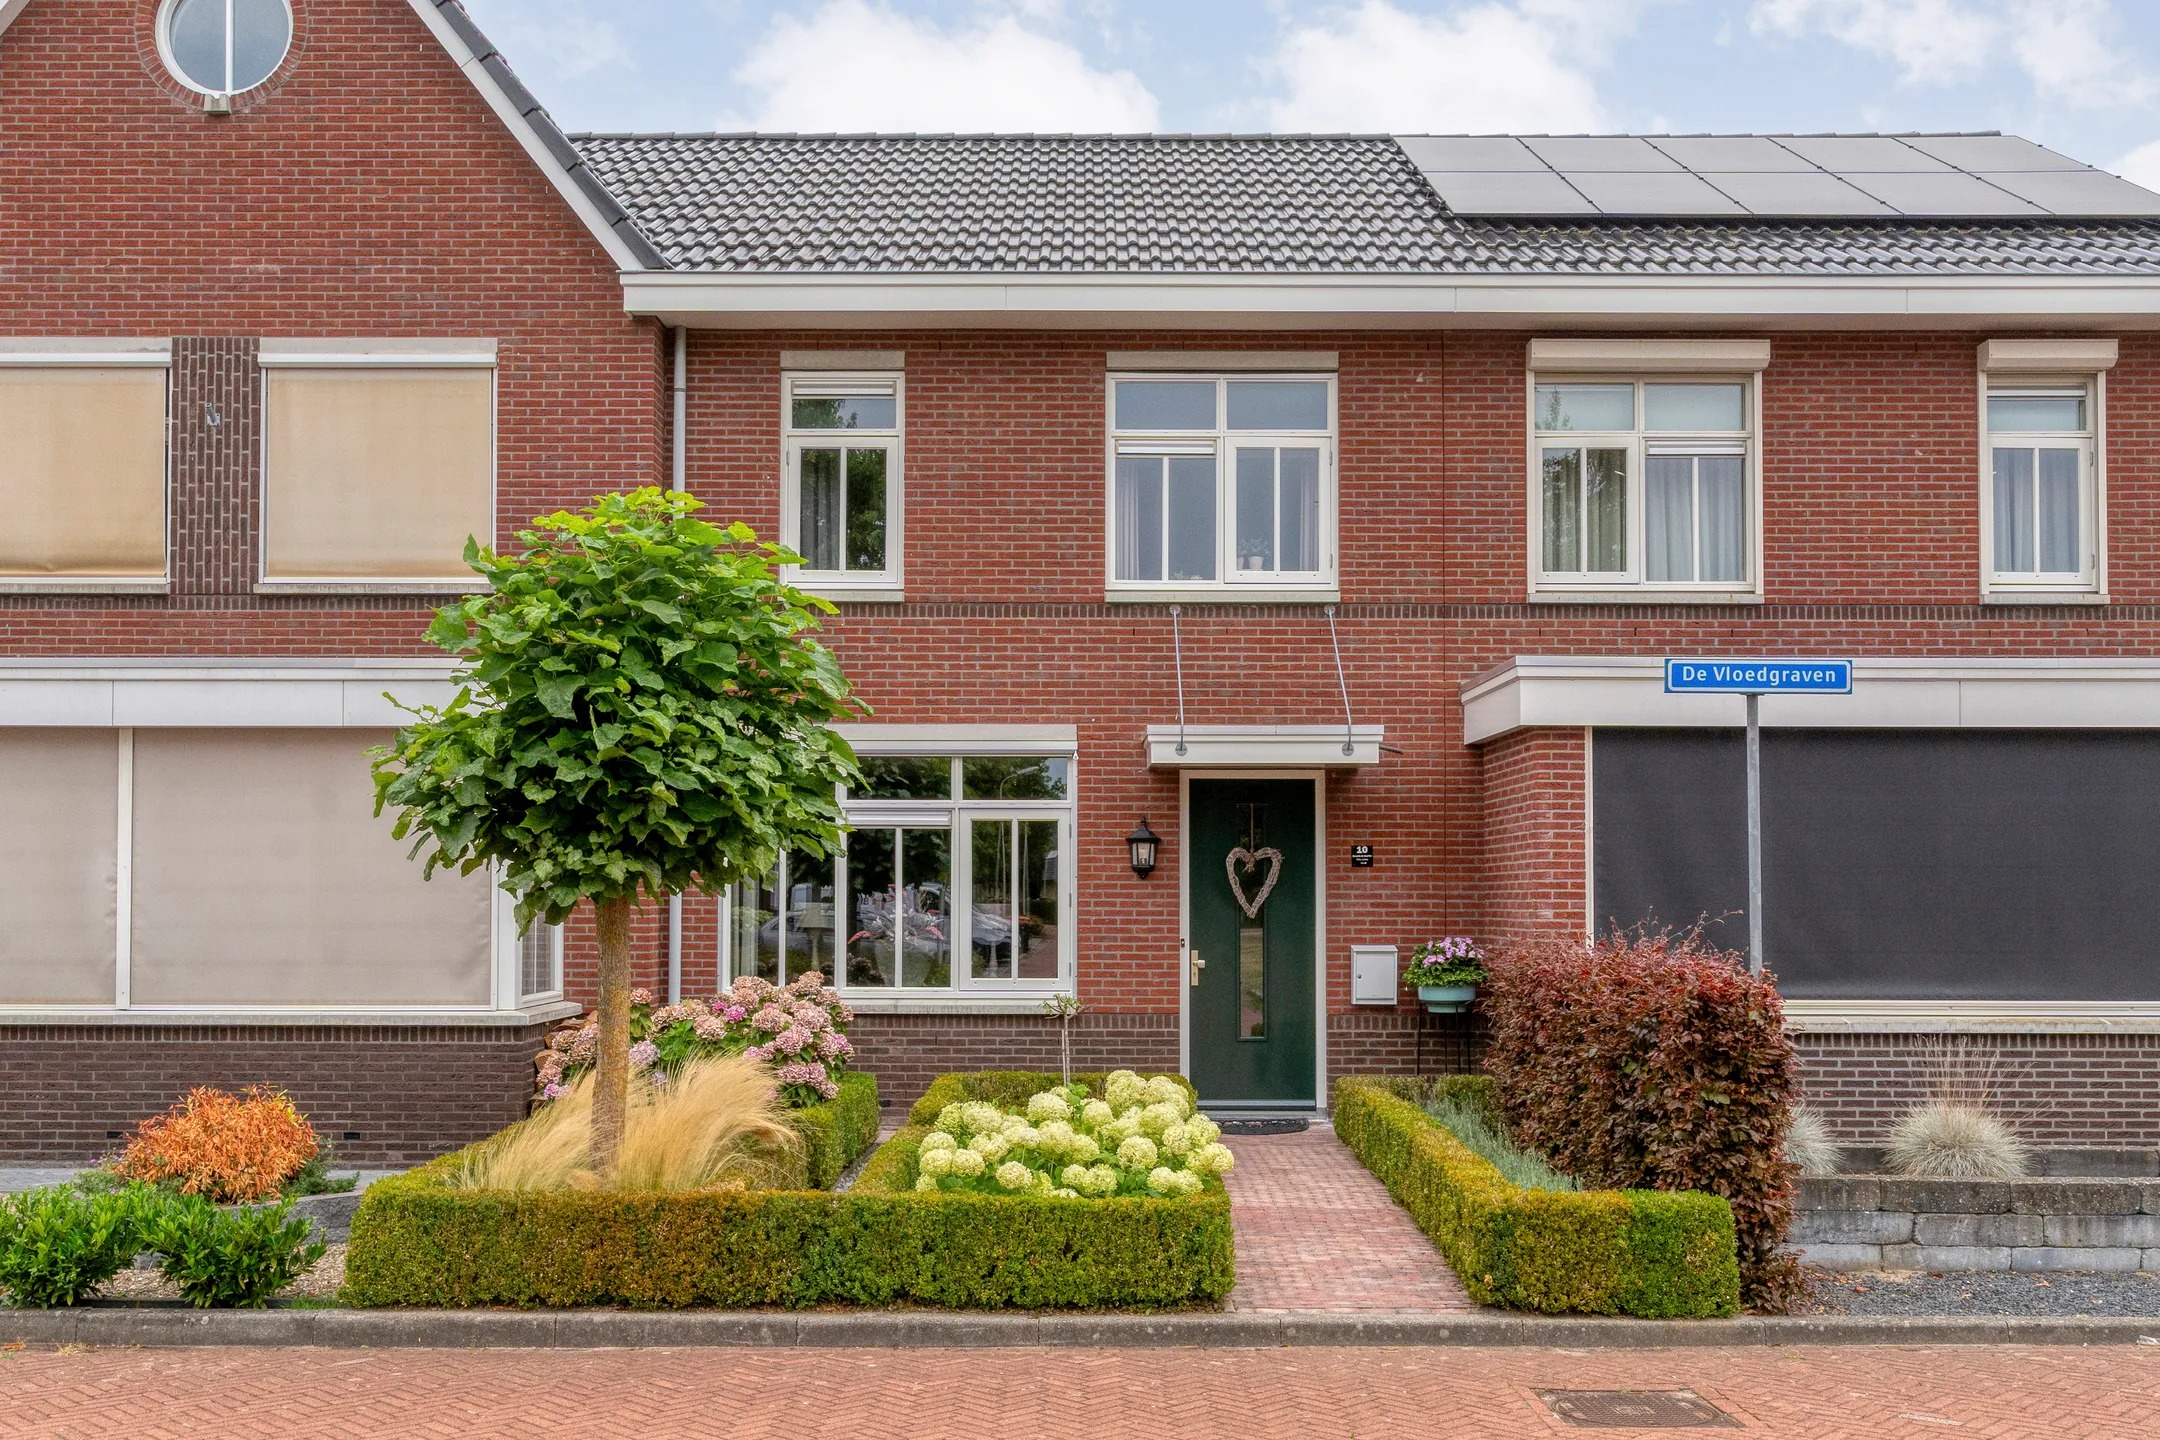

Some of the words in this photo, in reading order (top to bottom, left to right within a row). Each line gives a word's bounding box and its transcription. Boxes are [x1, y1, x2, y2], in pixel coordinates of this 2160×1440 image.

[1683, 666, 1706, 681] De
[1713, 666, 1836, 685] Vloedgraven
[1356, 846, 1368, 854] 10
